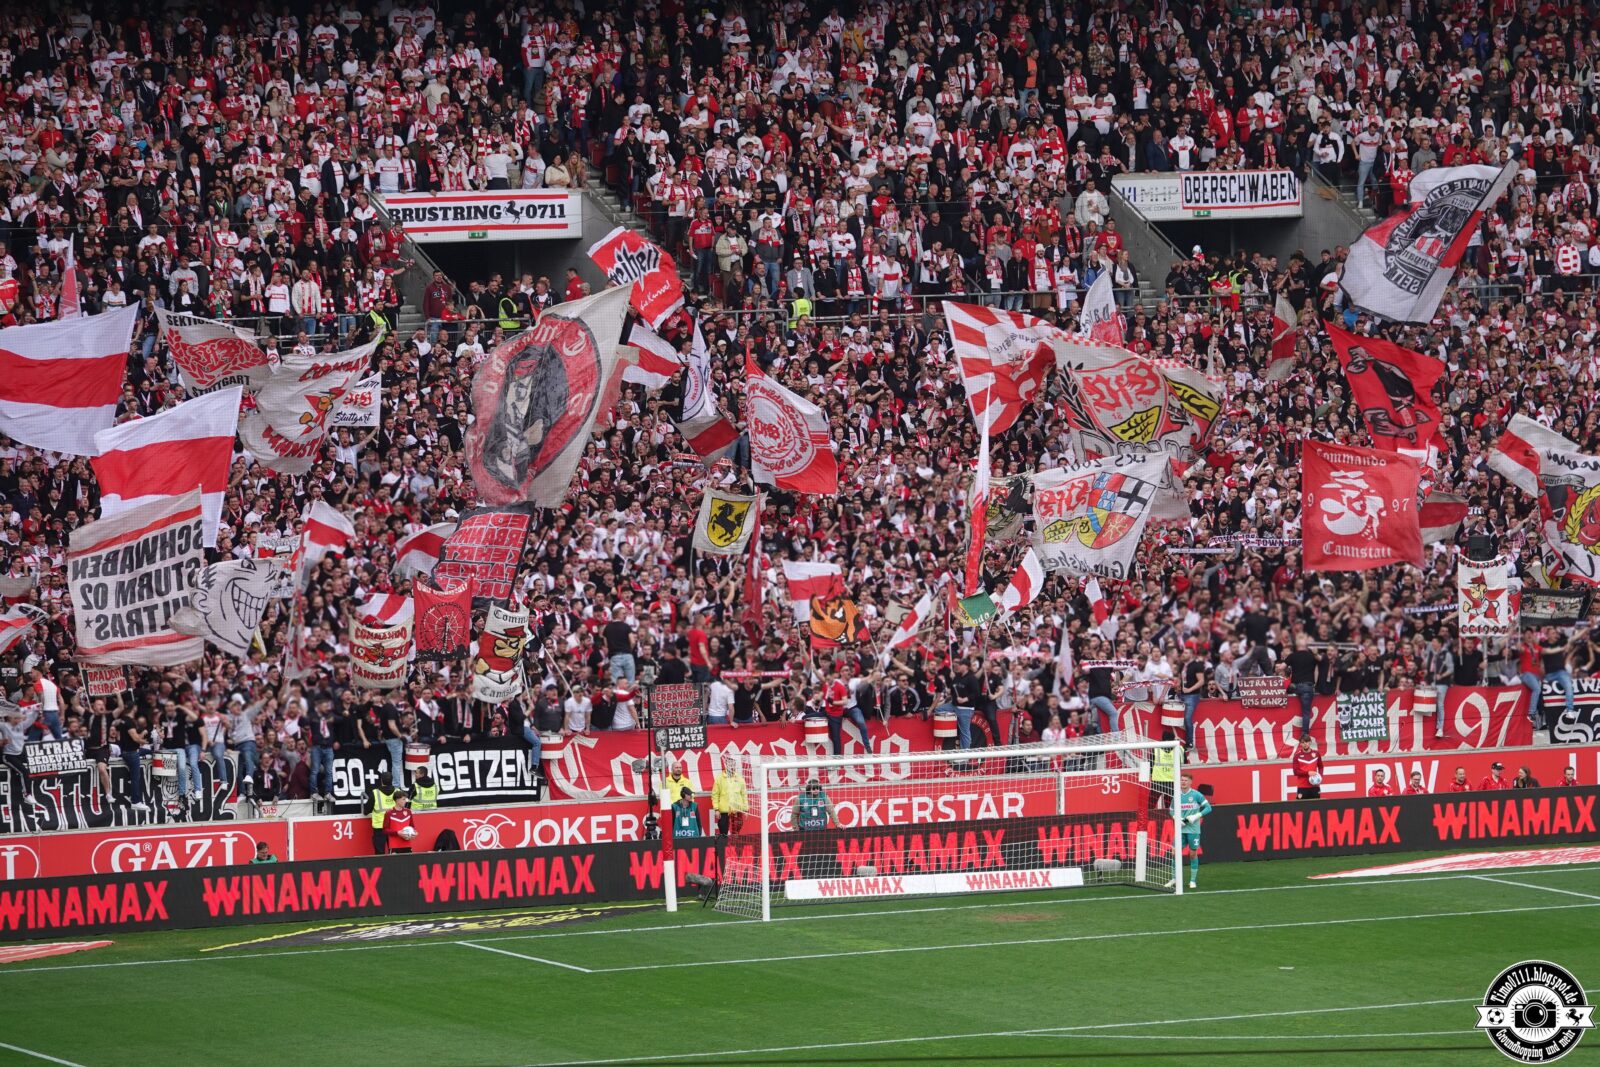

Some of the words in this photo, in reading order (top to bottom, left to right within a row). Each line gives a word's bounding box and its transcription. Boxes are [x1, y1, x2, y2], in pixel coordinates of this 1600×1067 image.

[1184, 172, 1297, 204] OBERSCHWABEN
[388, 204, 502, 222] BRUSTRING
[525, 203, 567, 219] 0711
[333, 411, 374, 425] Stuttgart
[1391, 497, 1410, 513] 97
[1322, 540, 1392, 559] Cannstatt
[650, 690, 699, 702] VERBANNTE
[655, 683, 693, 692] JEDER
[1350, 692, 1385, 703] MAGIC
[1352, 703, 1385, 717] FANS
[1454, 689, 1522, 749] 97
[684, 726, 704, 734] BIST
[1352, 717, 1385, 728] POUR
[668, 733, 705, 743] IMMER
[28, 752, 85, 766] BEDEUTET
[1101, 776, 1121, 795] 35
[825, 791, 1025, 829] OKERSTAR
[1432, 795, 1597, 841] WINAMAX
[332, 821, 355, 841] 34
[675, 829, 696, 837] HOST
[804, 819, 825, 828] HOST
[1236, 805, 1402, 852] WINAMAX
[836, 828, 1006, 877] WINAMAX
[418, 853, 596, 905] WINAMAX
[817, 876, 905, 897] WINAMAX
[966, 870, 1053, 890] WINAMAX
[203, 866, 383, 917] WINAMAX
[0, 879, 169, 931] WINAMAX
